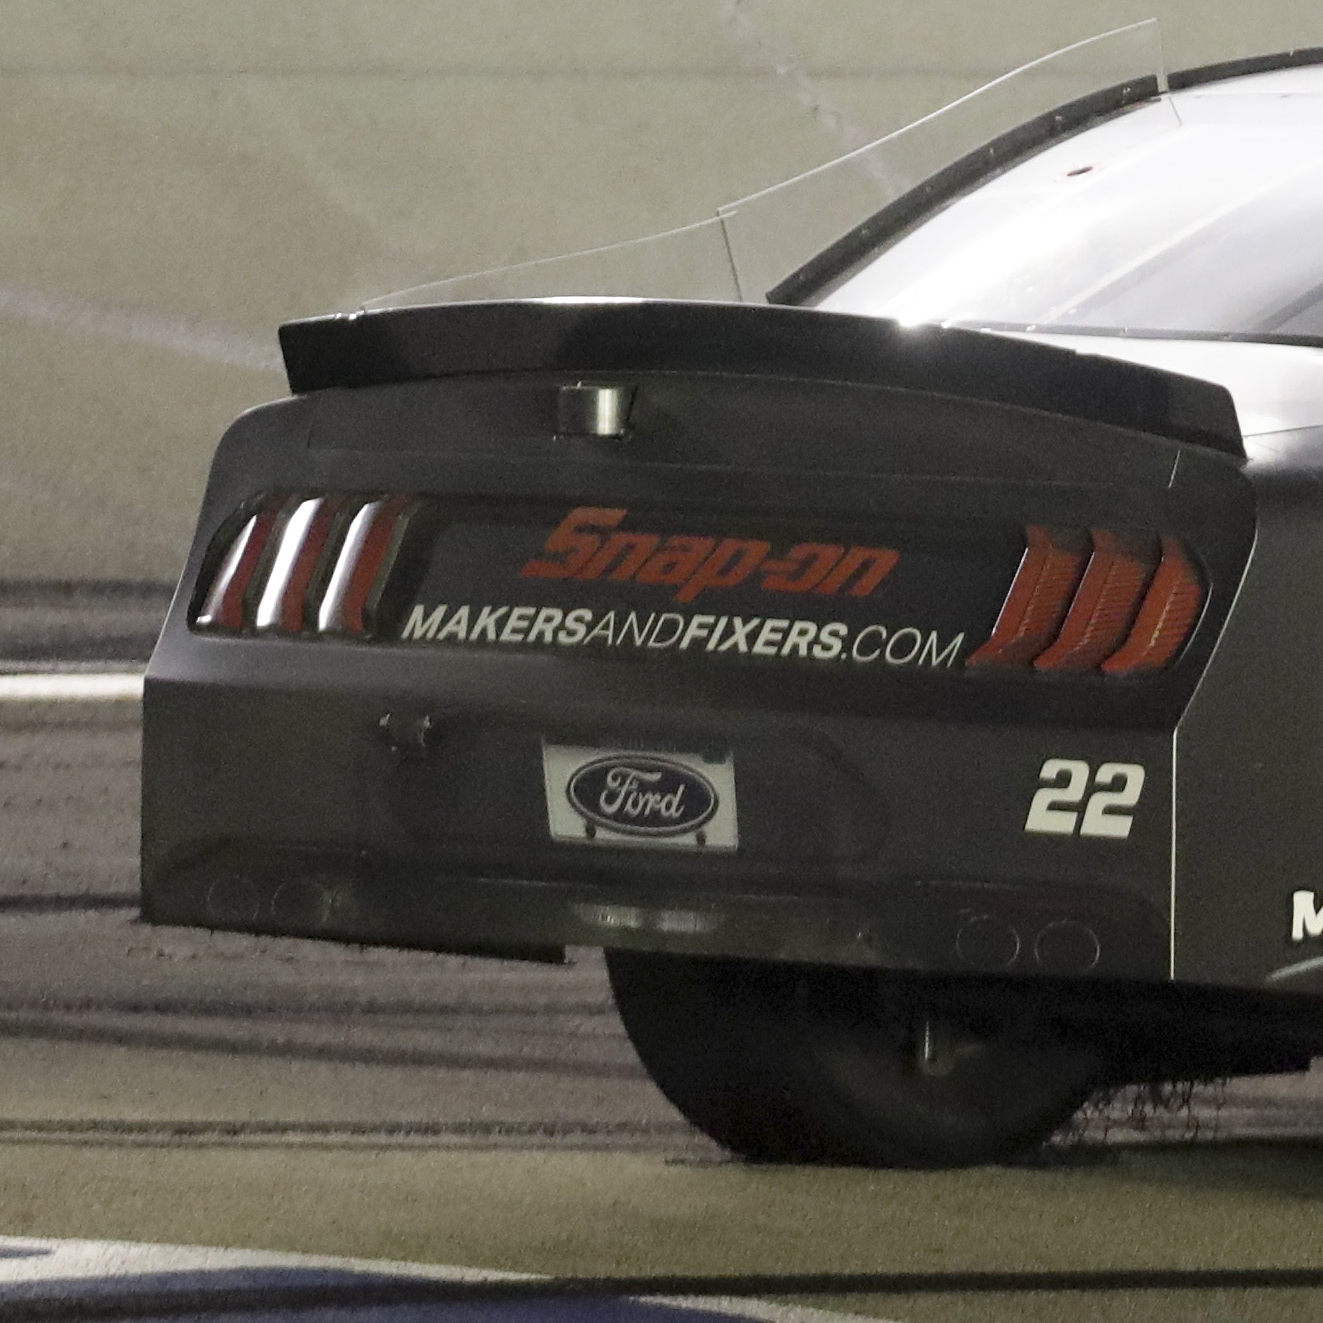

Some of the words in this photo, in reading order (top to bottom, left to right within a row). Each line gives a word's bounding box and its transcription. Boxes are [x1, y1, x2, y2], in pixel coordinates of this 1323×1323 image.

[520, 506, 901, 603] Snap-on
[401, 603, 966, 669] MAKERSANDFIXERS.COM
[599, 765, 688, 820] Ford
[1023, 757, 1147, 841] 22
